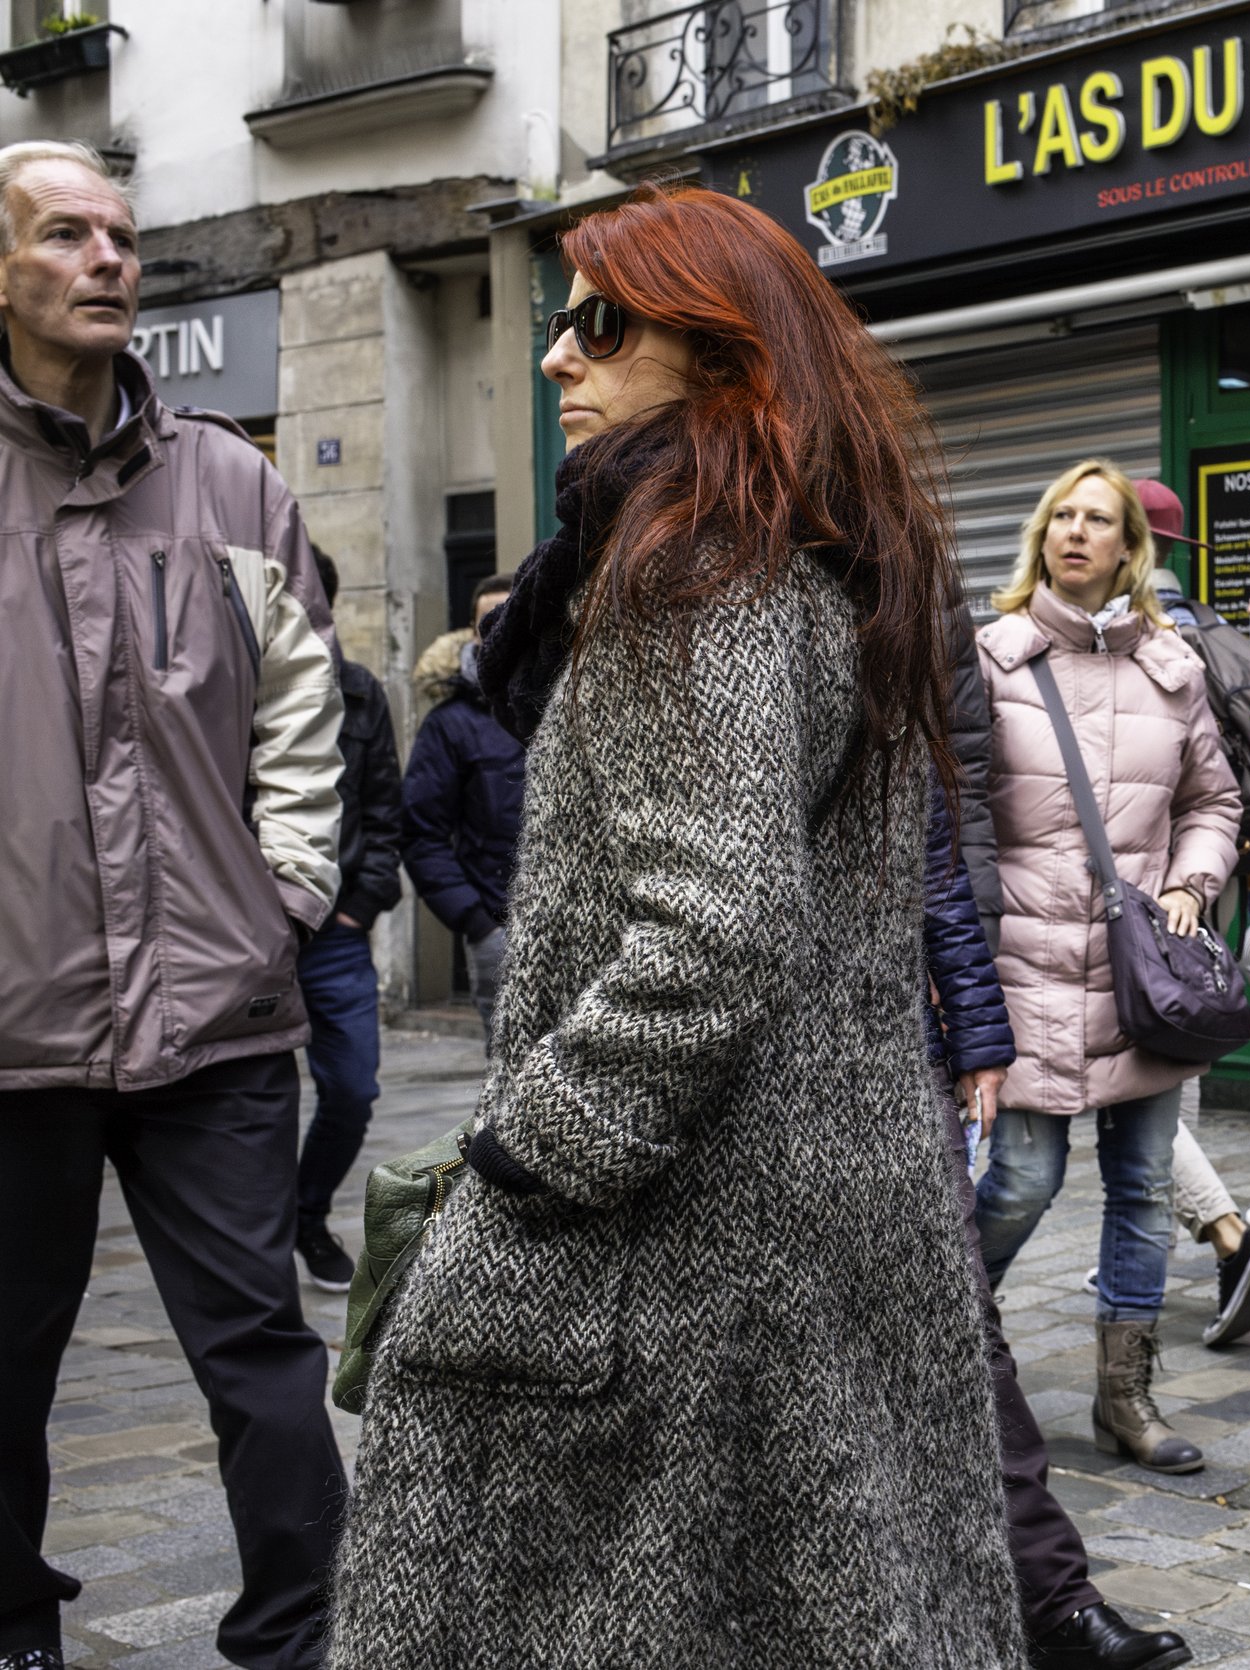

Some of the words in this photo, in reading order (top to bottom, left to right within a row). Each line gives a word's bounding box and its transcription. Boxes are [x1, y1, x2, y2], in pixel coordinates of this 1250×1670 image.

[985, 71, 1126, 185] L'AS
[1142, 37, 1244, 149] DU
[1097, 182, 1142, 208] SOUS
[1145, 177, 1166, 197] LE
